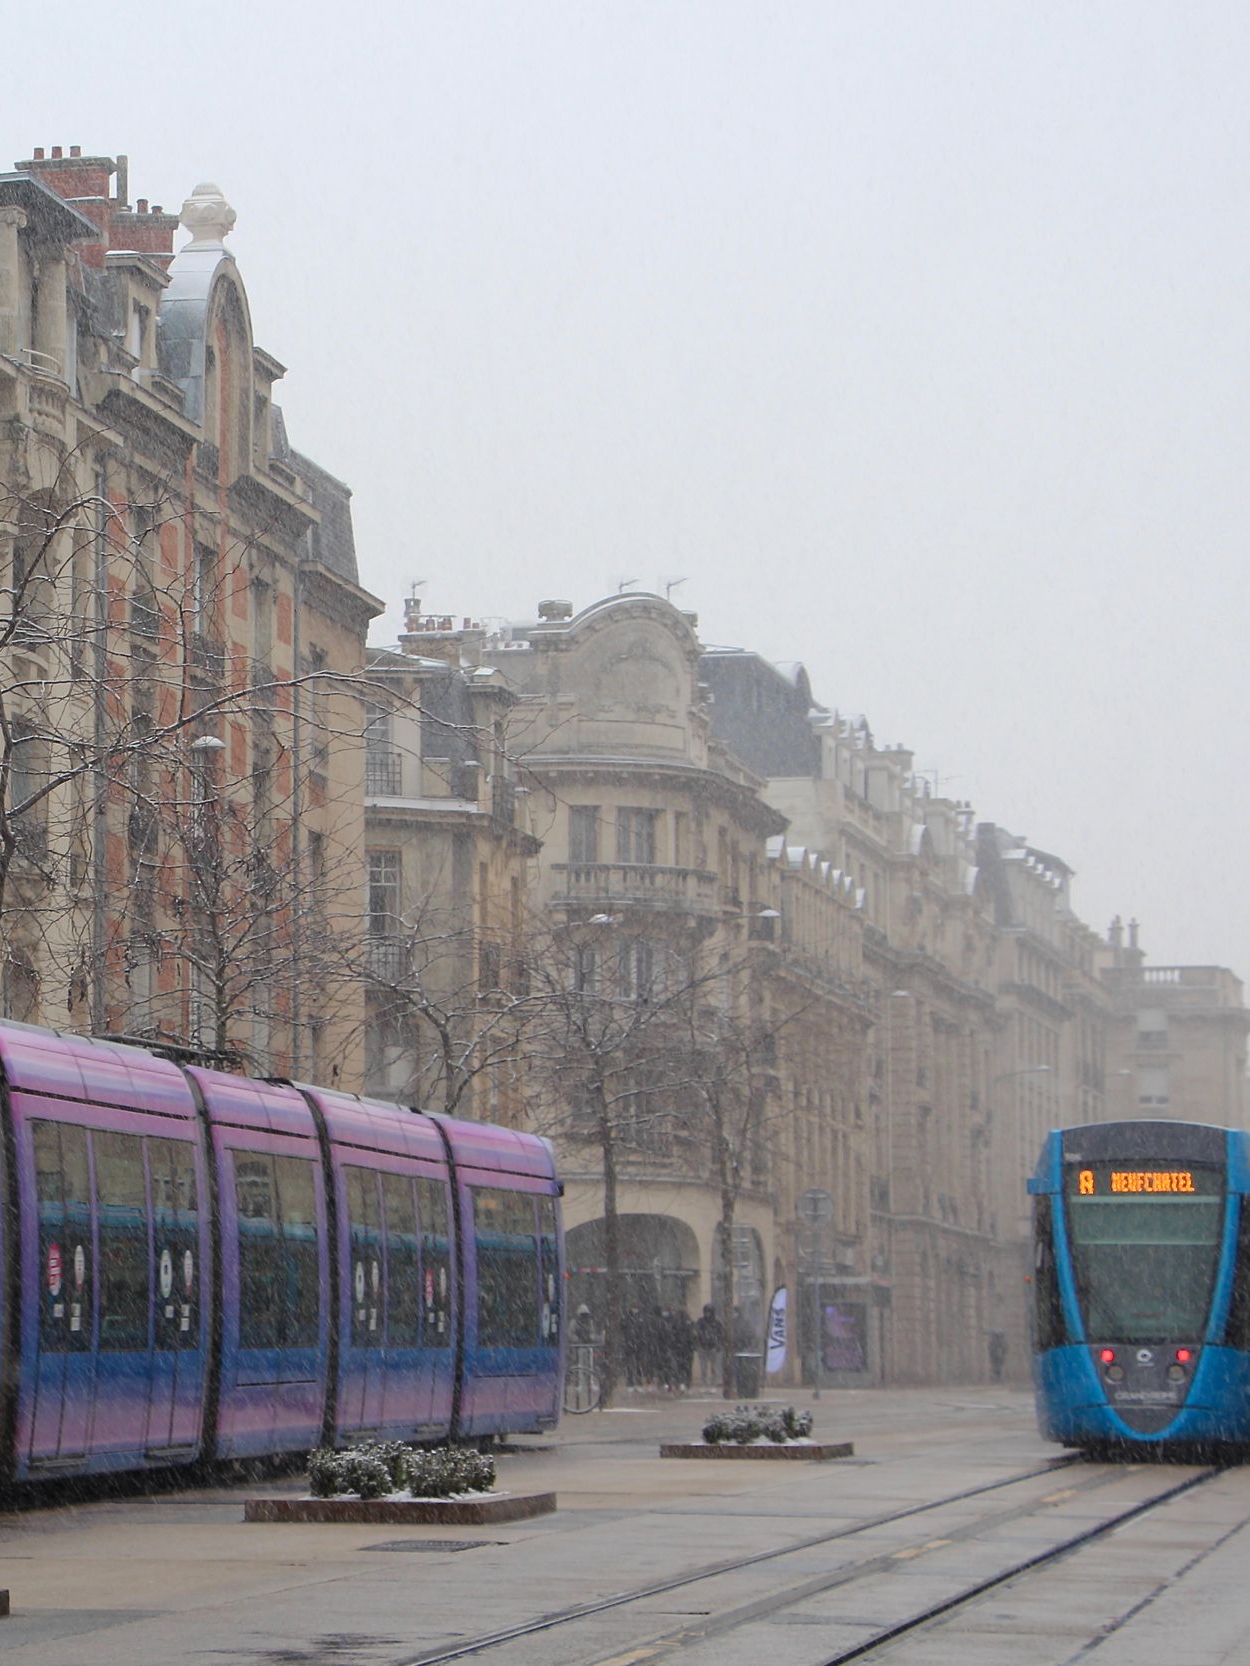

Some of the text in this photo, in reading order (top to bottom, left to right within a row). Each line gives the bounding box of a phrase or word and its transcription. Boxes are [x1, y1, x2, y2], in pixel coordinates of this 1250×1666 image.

[1079, 1170, 1195, 1195] A NEUFCHATEL
[769, 1307, 786, 1350] VANS
